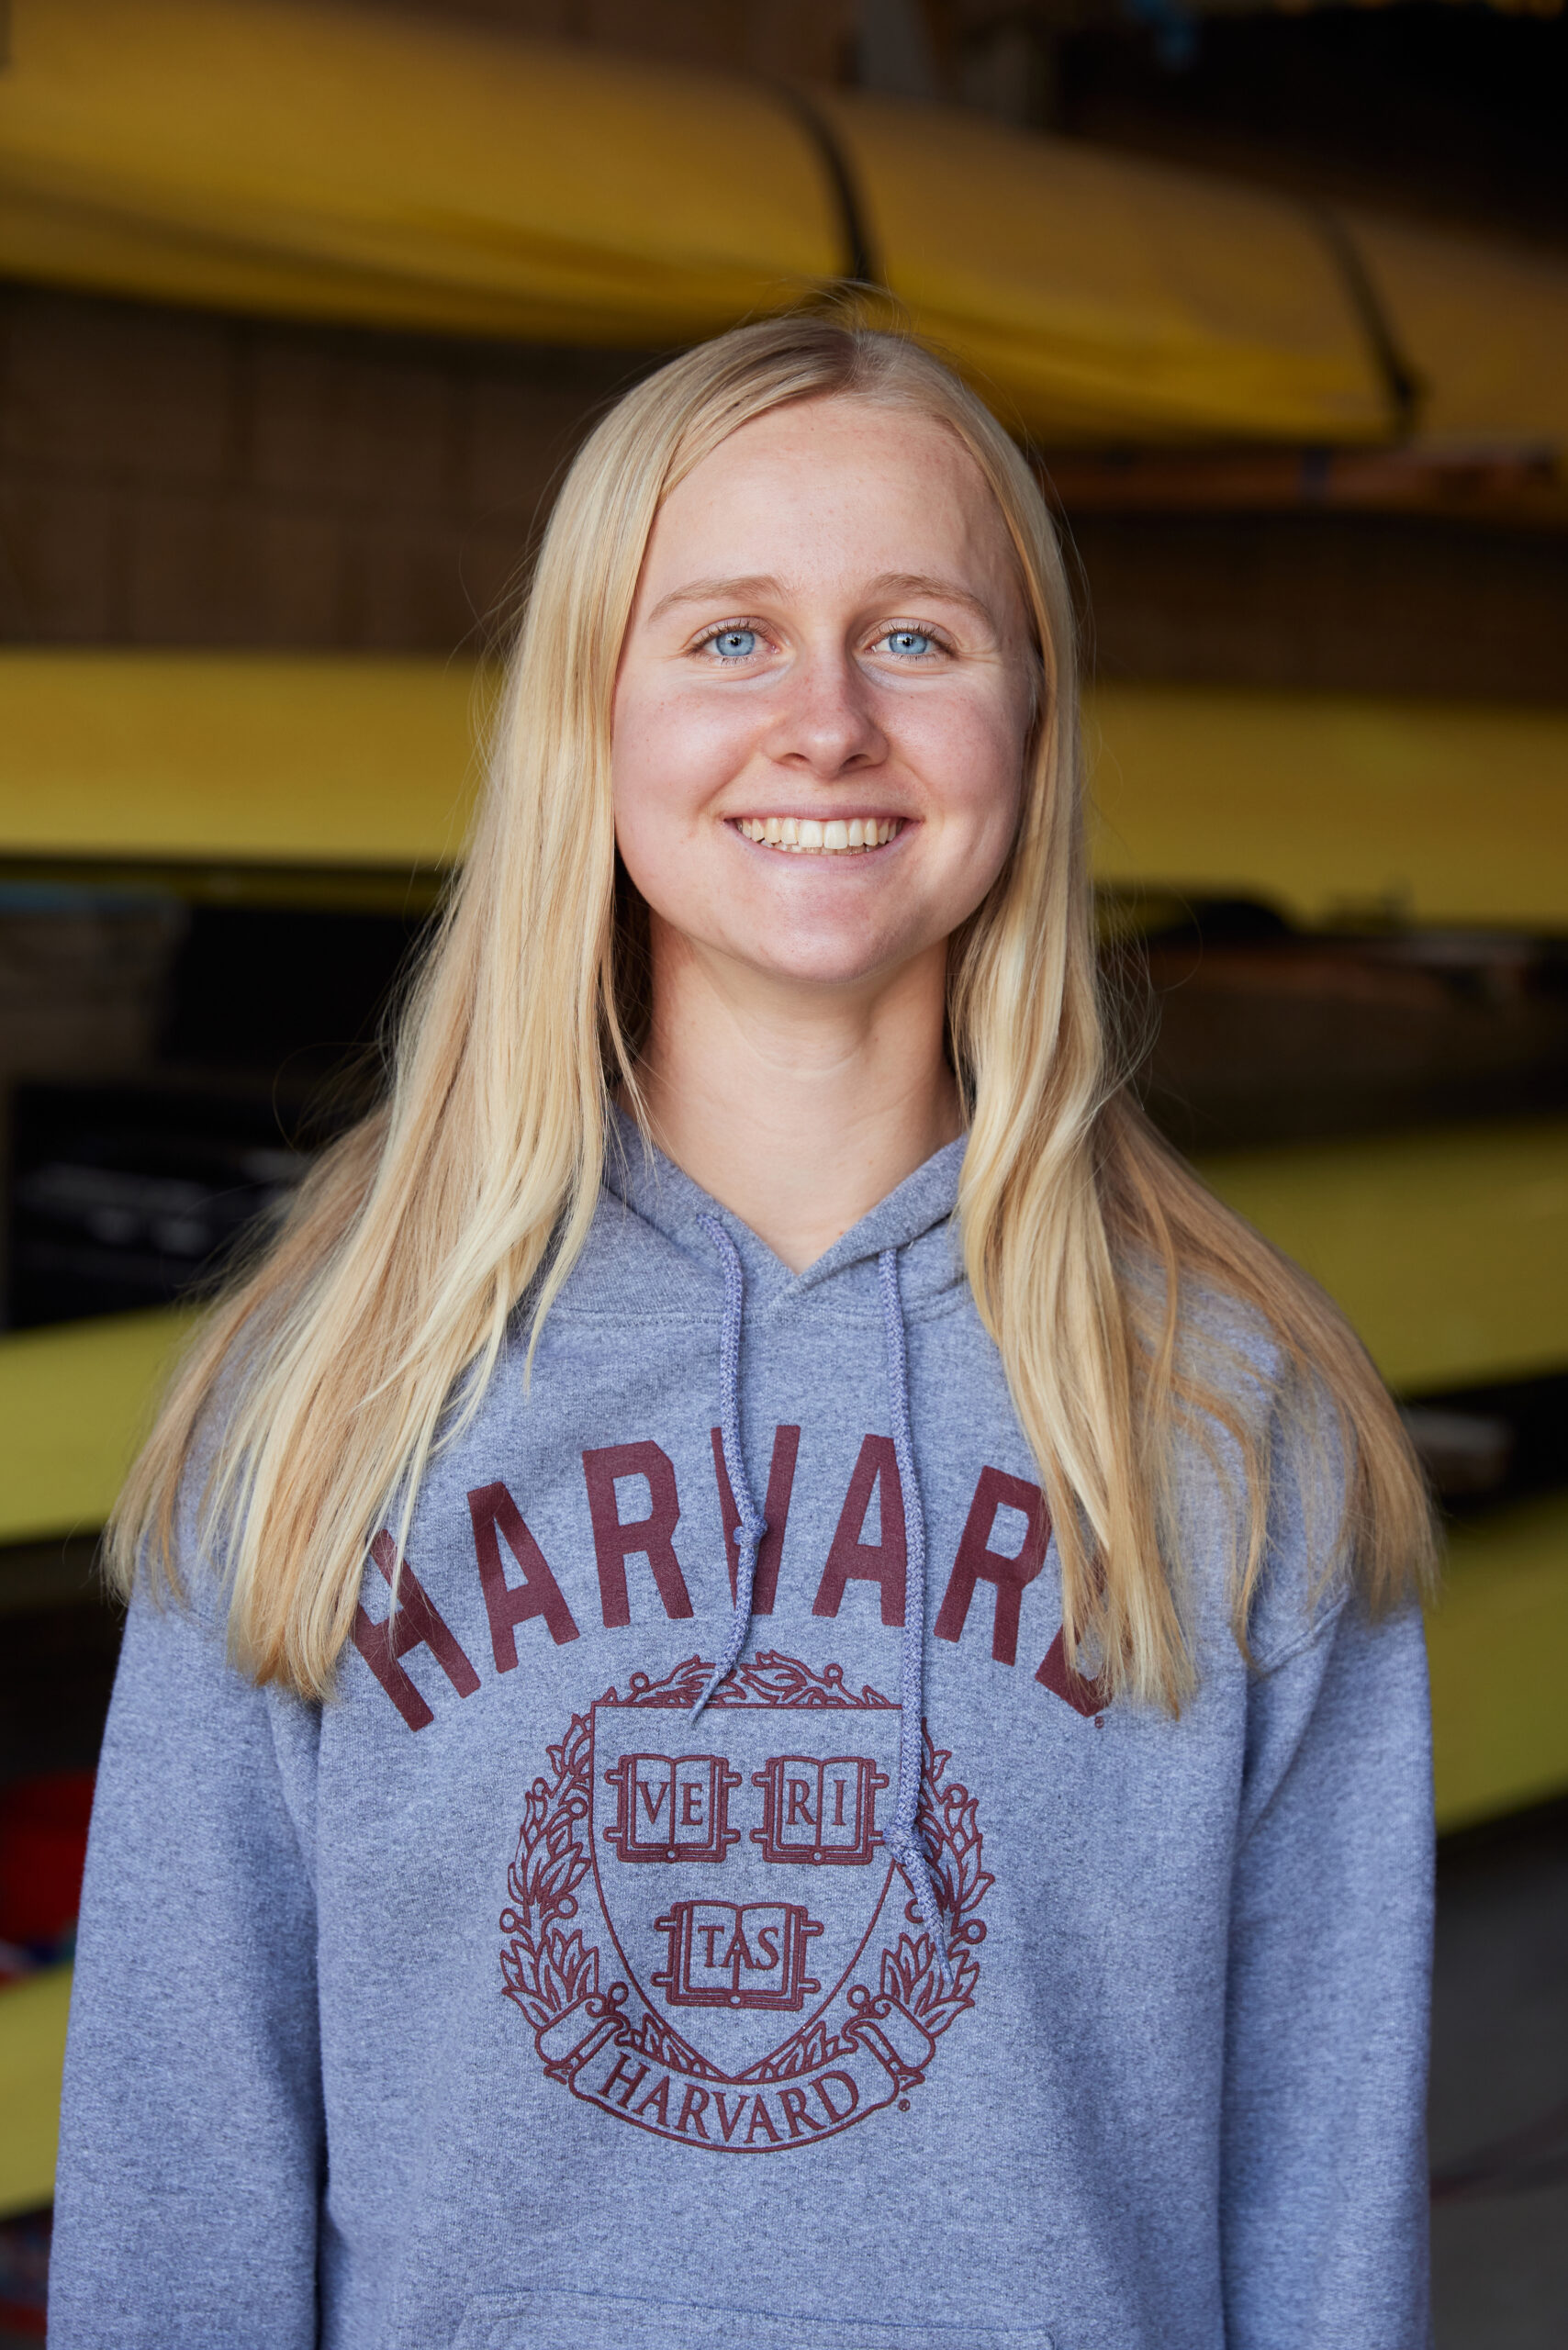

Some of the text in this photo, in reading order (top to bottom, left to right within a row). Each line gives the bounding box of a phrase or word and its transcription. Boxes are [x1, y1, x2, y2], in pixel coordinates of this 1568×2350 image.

[637, 1778, 847, 1827] VE RI
[697, 1925, 781, 1971] TAS
[597, 2052, 860, 2144] HARVARD
